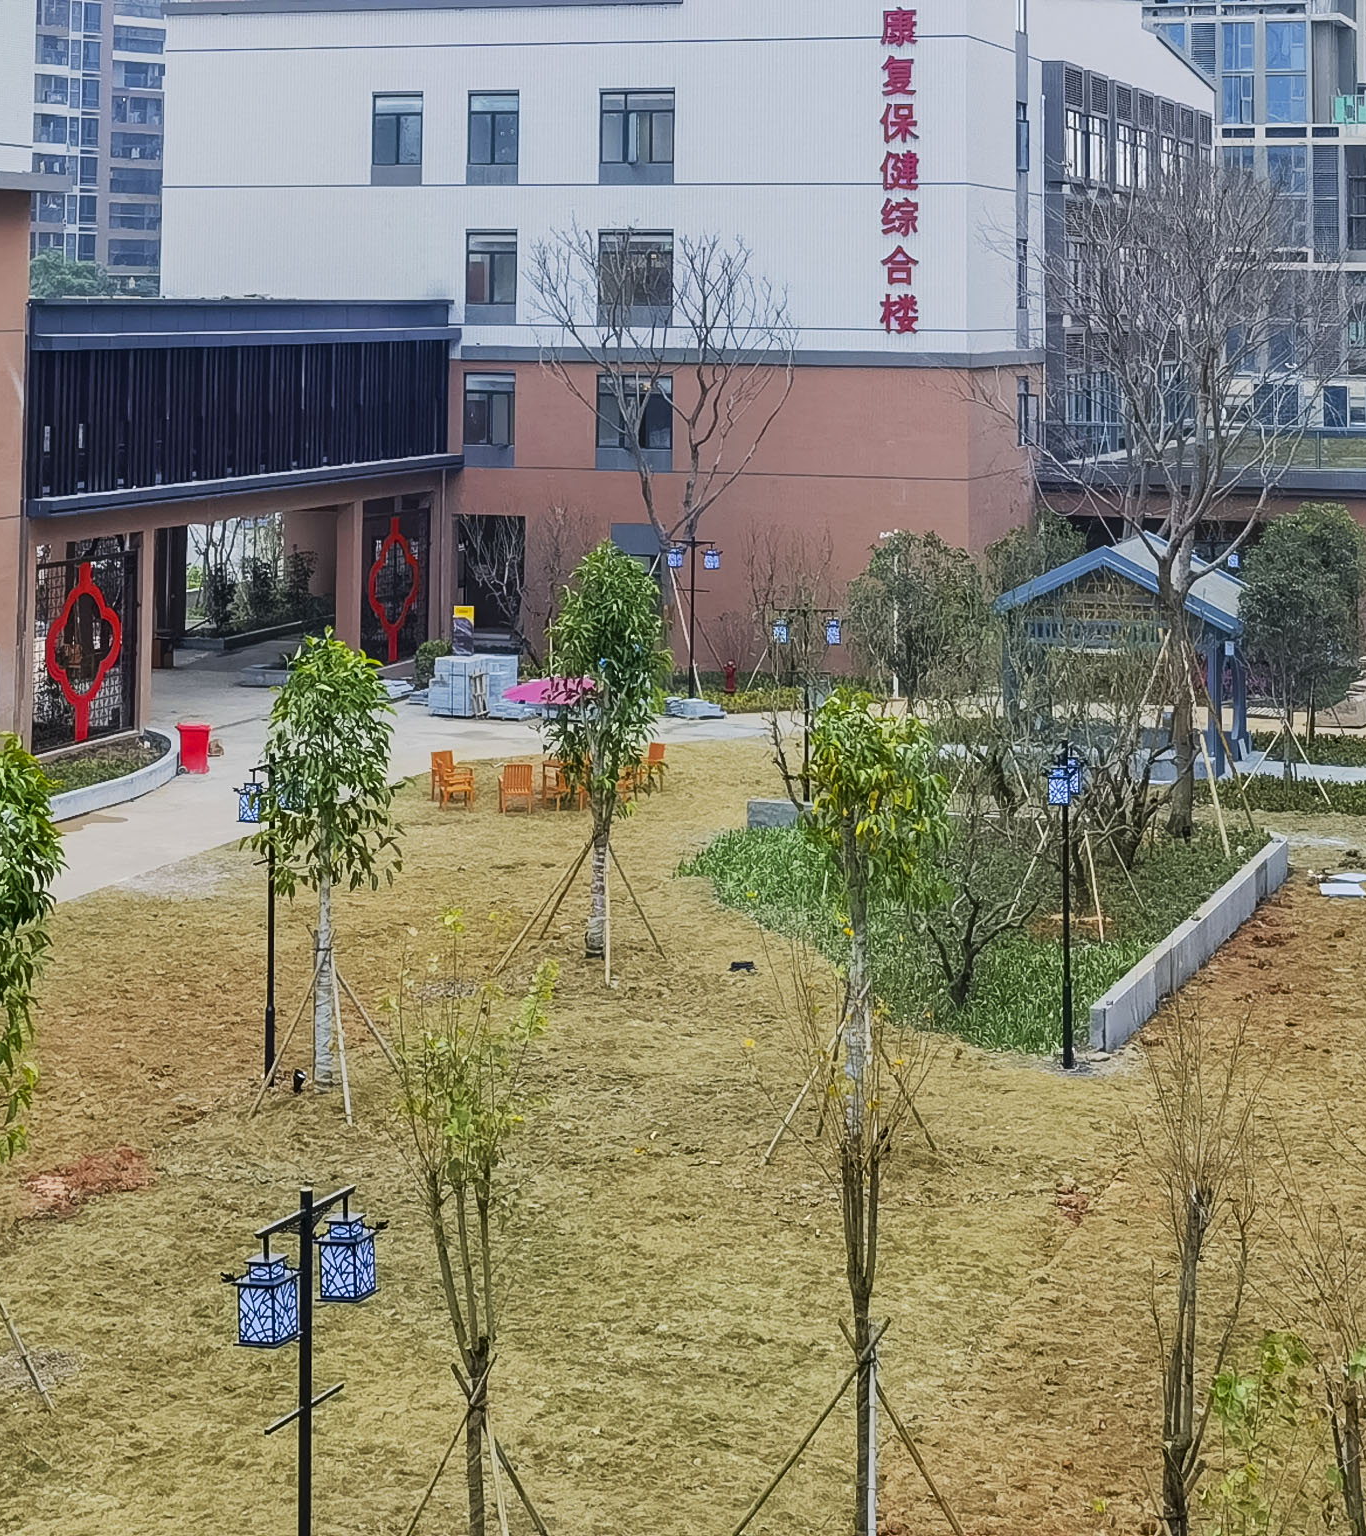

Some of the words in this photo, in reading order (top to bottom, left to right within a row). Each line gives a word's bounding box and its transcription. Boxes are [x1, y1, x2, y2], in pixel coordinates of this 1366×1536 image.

[879, 6, 920, 335] 康复保健综合楼
